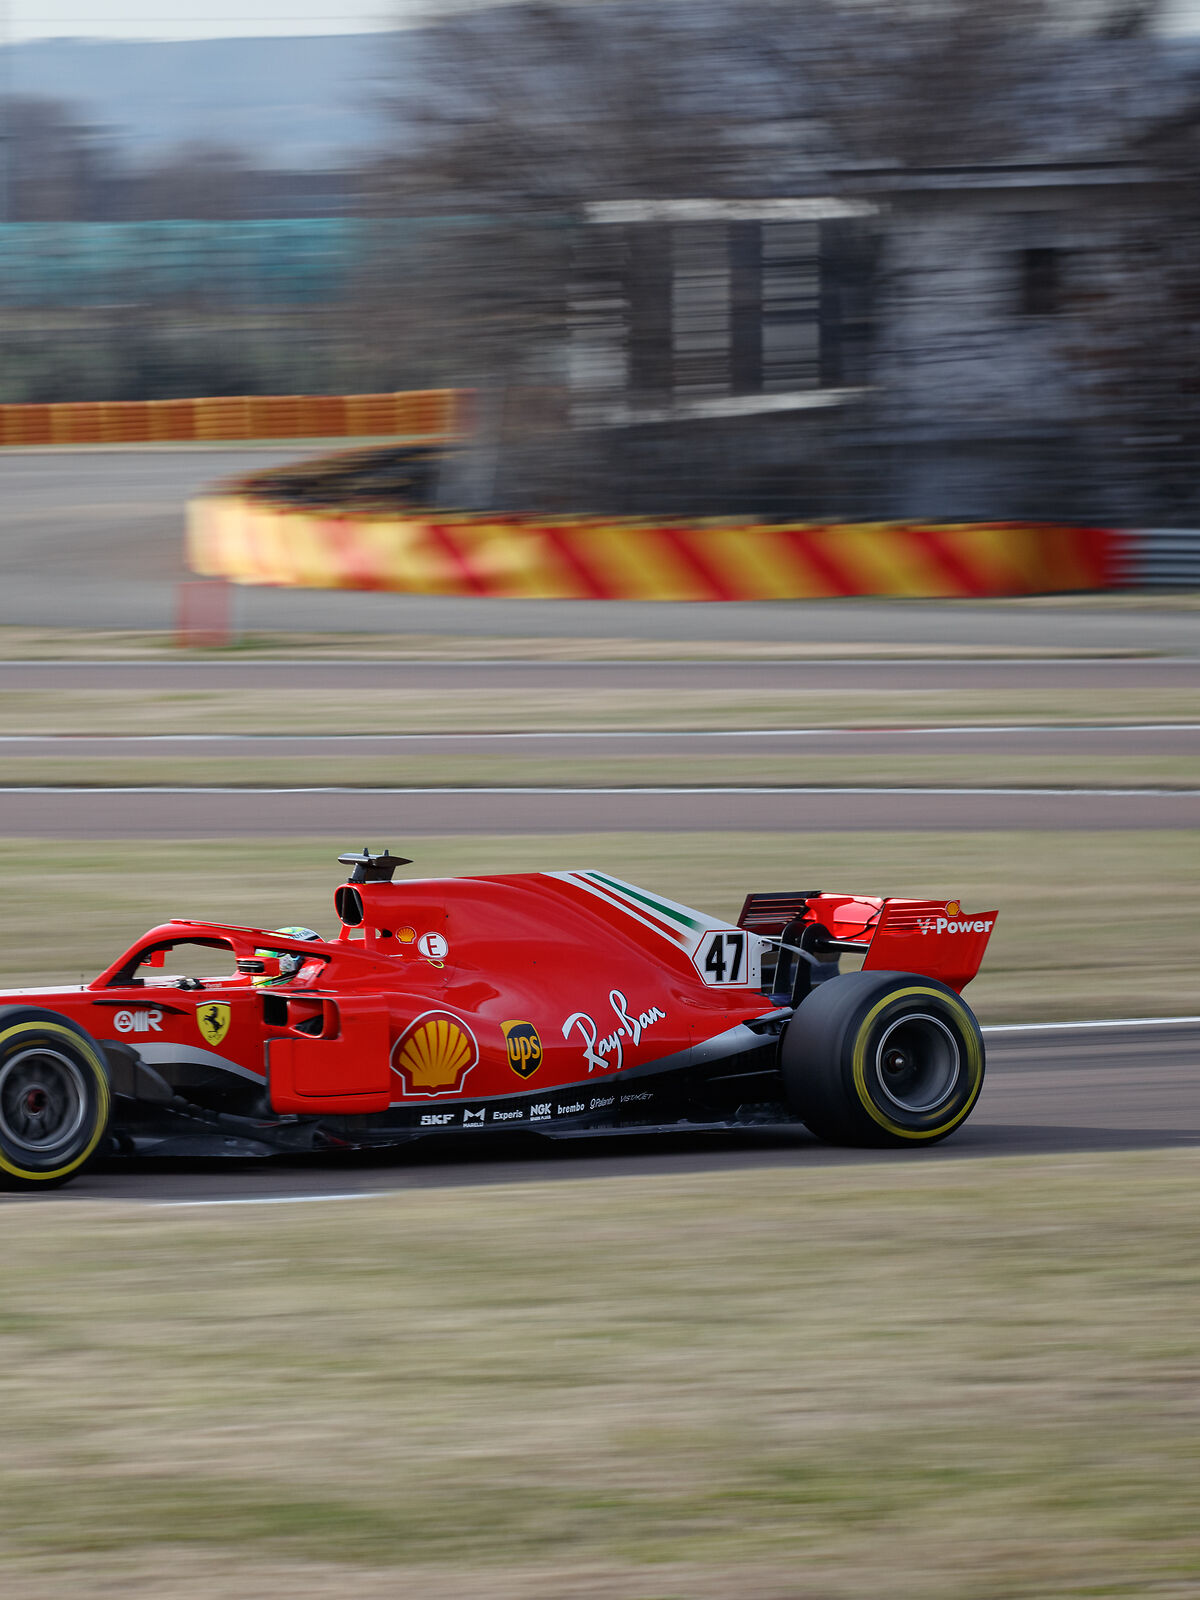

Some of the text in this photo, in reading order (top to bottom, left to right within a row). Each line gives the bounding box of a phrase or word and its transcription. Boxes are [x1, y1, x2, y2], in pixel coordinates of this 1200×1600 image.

[425, 935, 442, 956] E
[705, 933, 744, 982] 47
[493, 1109, 523, 1121] Experis
[530, 1103, 552, 1116] NGK
[557, 1102, 585, 1115] brembo
[420, 1114, 455, 1126] SKF
